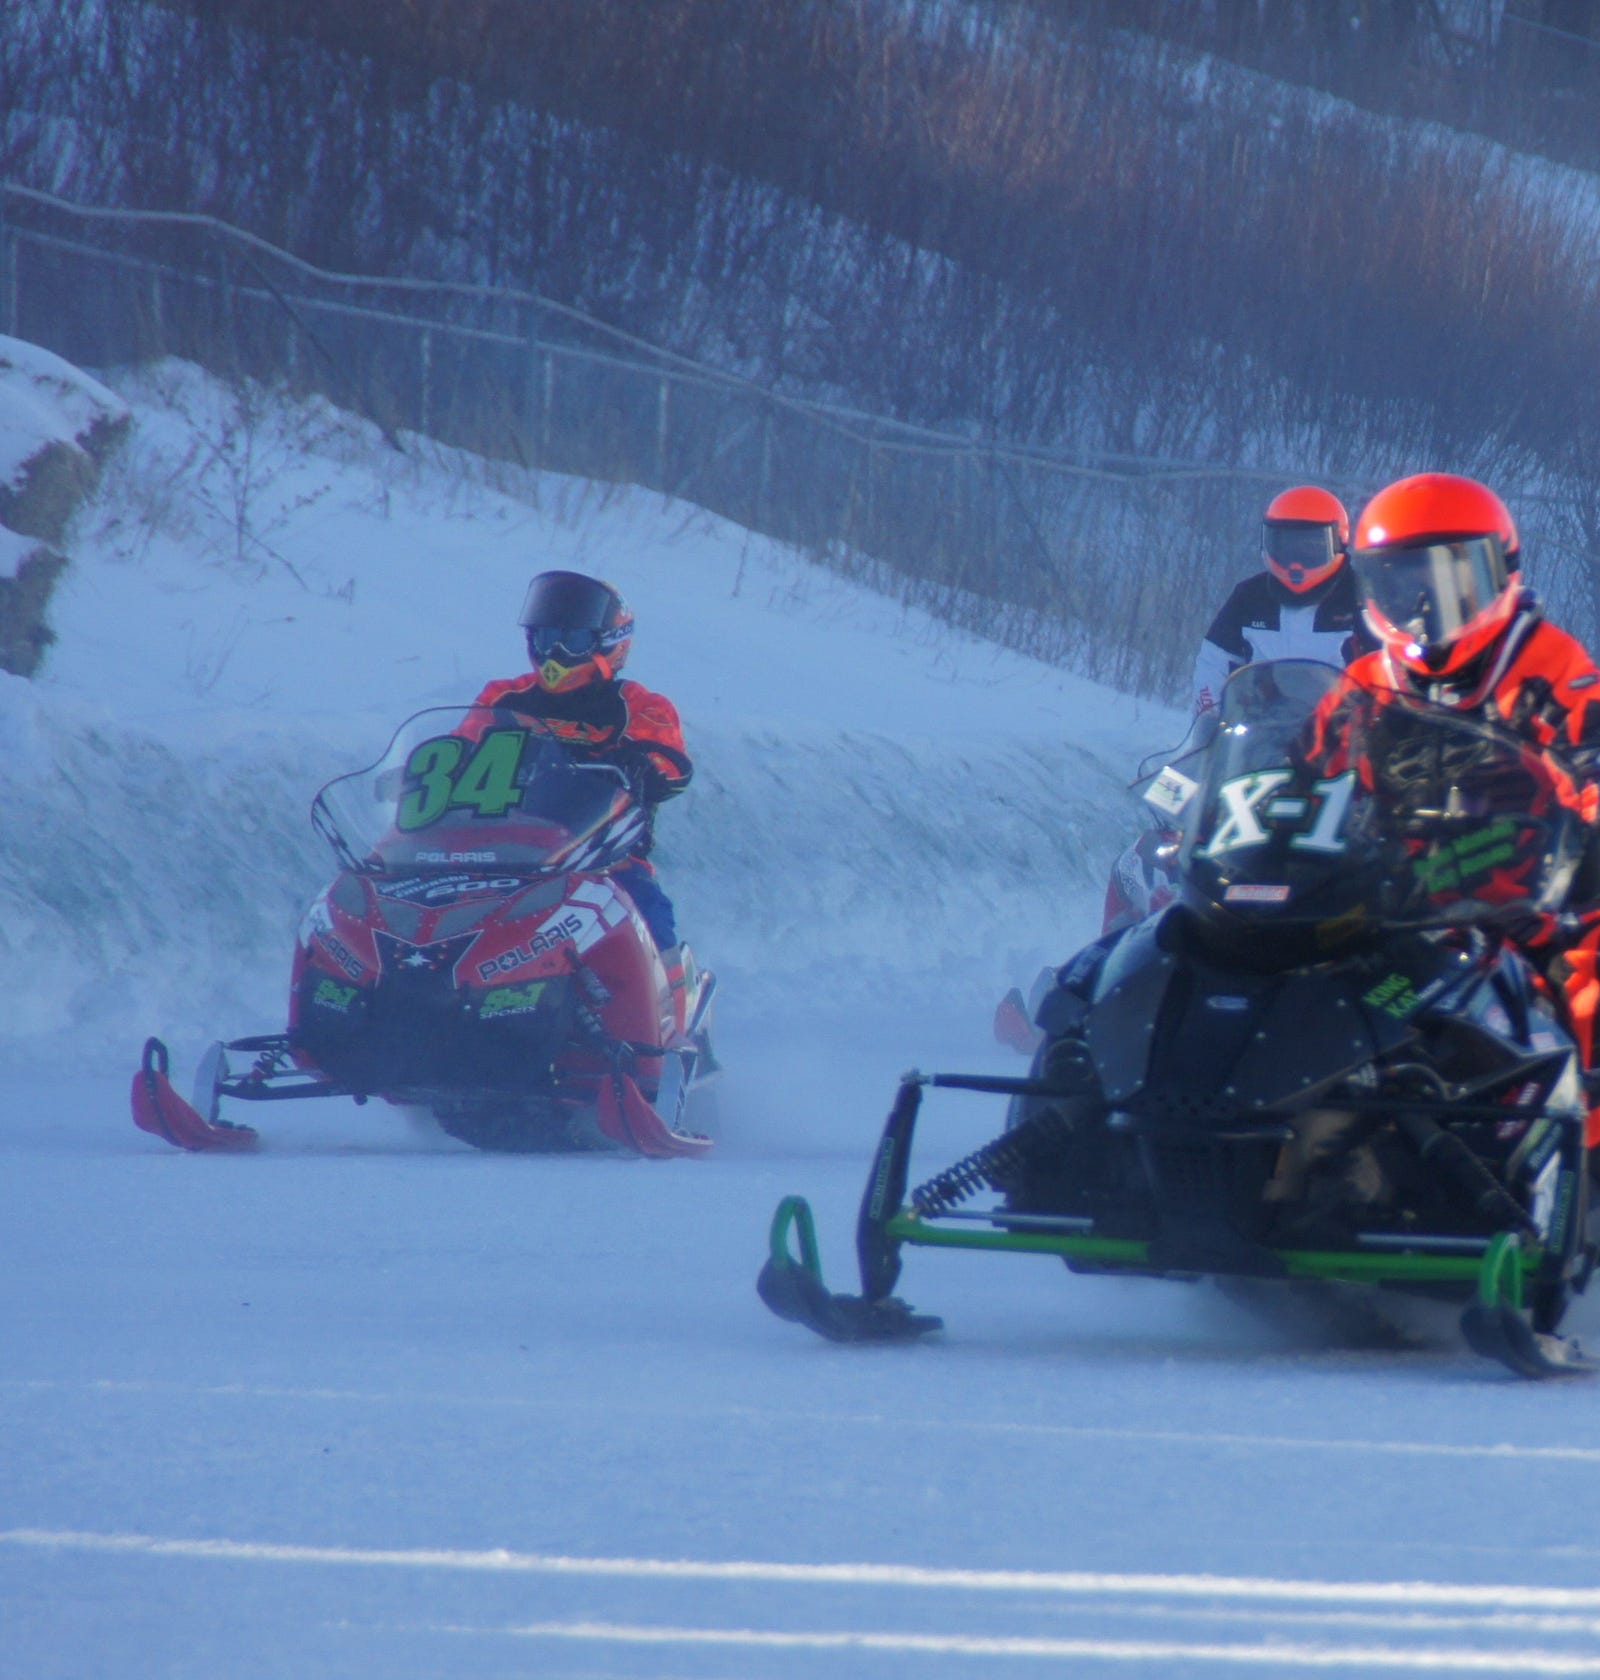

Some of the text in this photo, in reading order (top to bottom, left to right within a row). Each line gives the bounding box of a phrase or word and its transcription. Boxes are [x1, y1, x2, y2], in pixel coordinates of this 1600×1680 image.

[397, 731, 528, 831] 34
[1194, 768, 1358, 857] X-1
[415, 851, 497, 863] POLARIS
[425, 878, 521, 899] 600
[476, 913, 583, 982] POLARIS
